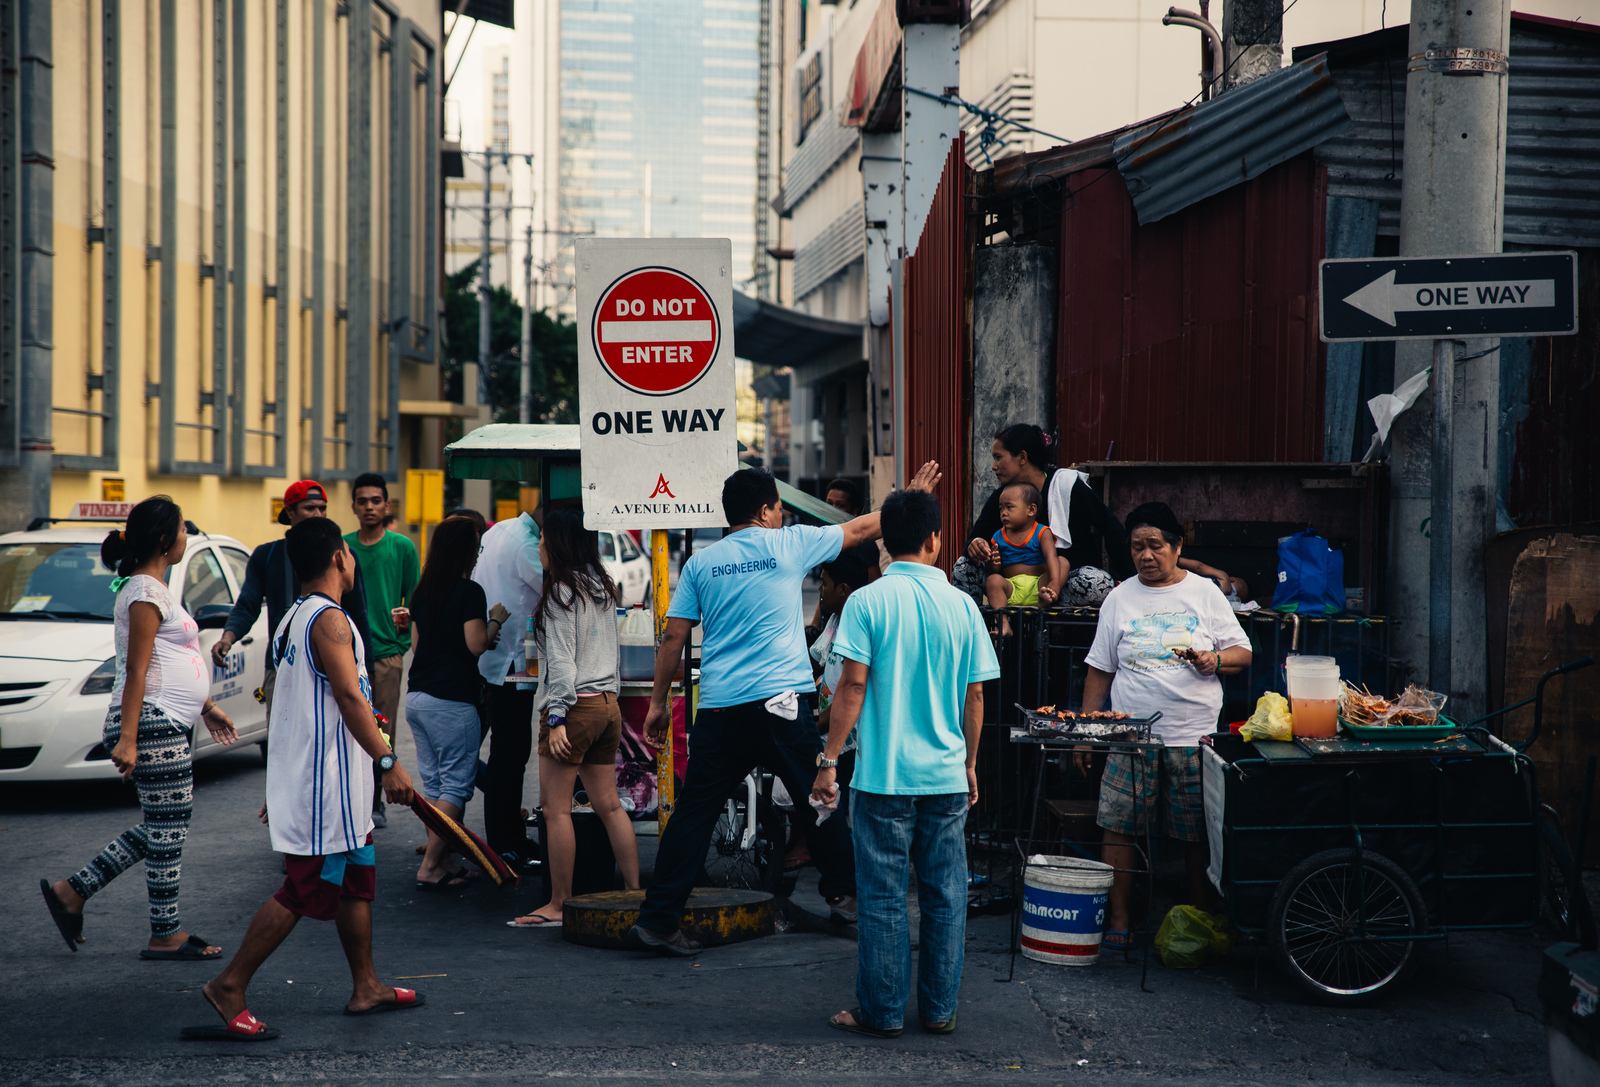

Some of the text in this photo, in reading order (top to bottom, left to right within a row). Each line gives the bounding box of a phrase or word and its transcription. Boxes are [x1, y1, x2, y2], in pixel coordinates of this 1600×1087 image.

[1416, 286, 1530, 306] ONE WAY
[615, 298, 696, 317] DO NOT
[622, 346, 693, 364] ENTER
[592, 408, 726, 436] ONE WAY
[611, 503, 715, 515] A.VENUE MALL
[711, 557, 777, 578] ENGINEERING
